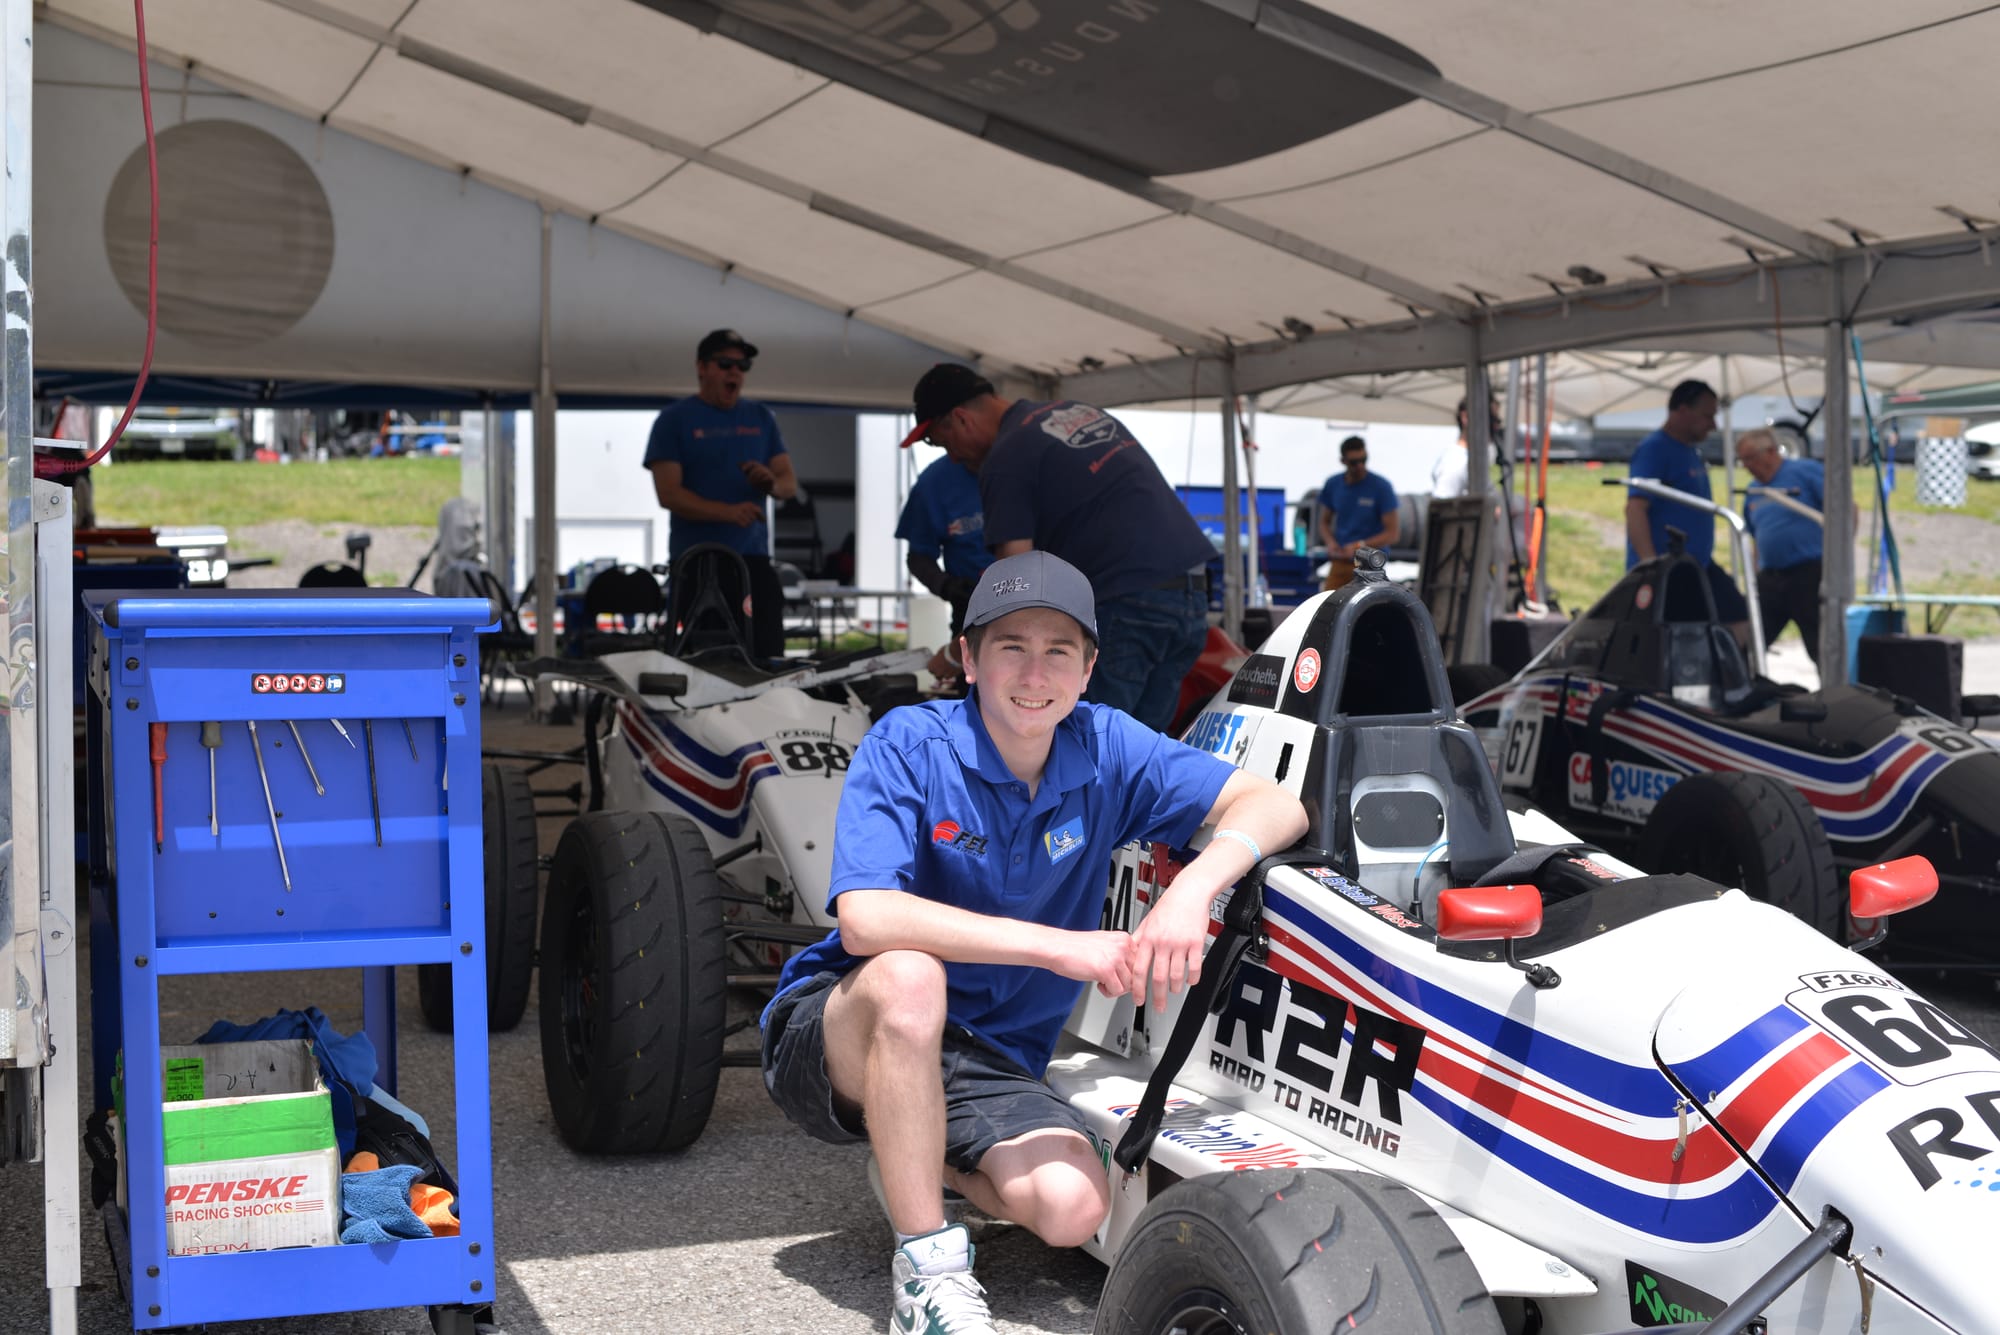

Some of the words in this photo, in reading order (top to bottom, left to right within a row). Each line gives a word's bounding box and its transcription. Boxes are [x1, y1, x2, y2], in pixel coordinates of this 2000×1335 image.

[1234, 664, 1279, 687] ouchette.
[780, 742, 851, 771] 88
[1506, 719, 1538, 776] 67
[1570, 755, 1678, 801] CAQUES
[953, 831, 989, 855] FEL
[1213, 960, 1428, 1127] R2R
[1821, 994, 2000, 1068] 64
[1209, 1049, 1266, 1094] ROAD
[1273, 1079, 1302, 1113] TO
[1307, 1096, 1401, 1158] RACING
[166, 1175, 308, 1207] PENSKE
[174, 1207, 229, 1223] RACING
[233, 1202, 293, 1218] SHOCKS
